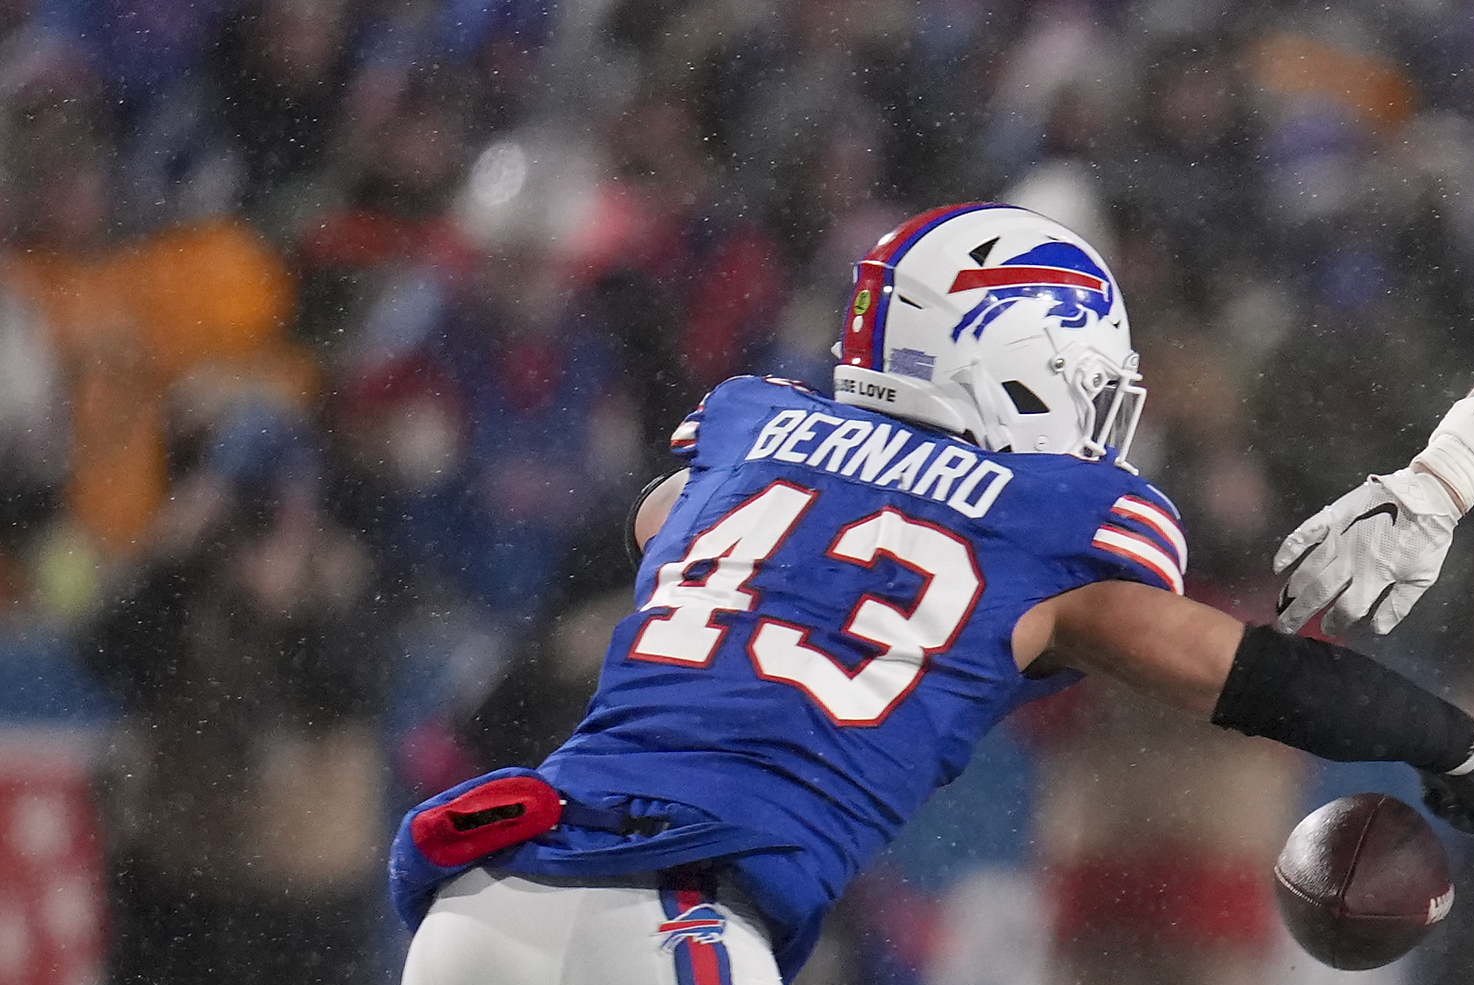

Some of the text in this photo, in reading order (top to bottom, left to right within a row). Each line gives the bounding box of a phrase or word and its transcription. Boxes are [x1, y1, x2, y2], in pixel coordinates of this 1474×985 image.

[858, 381, 897, 403] LOVE
[745, 409, 1015, 519] BERNARD
[628, 479, 986, 728] 43
